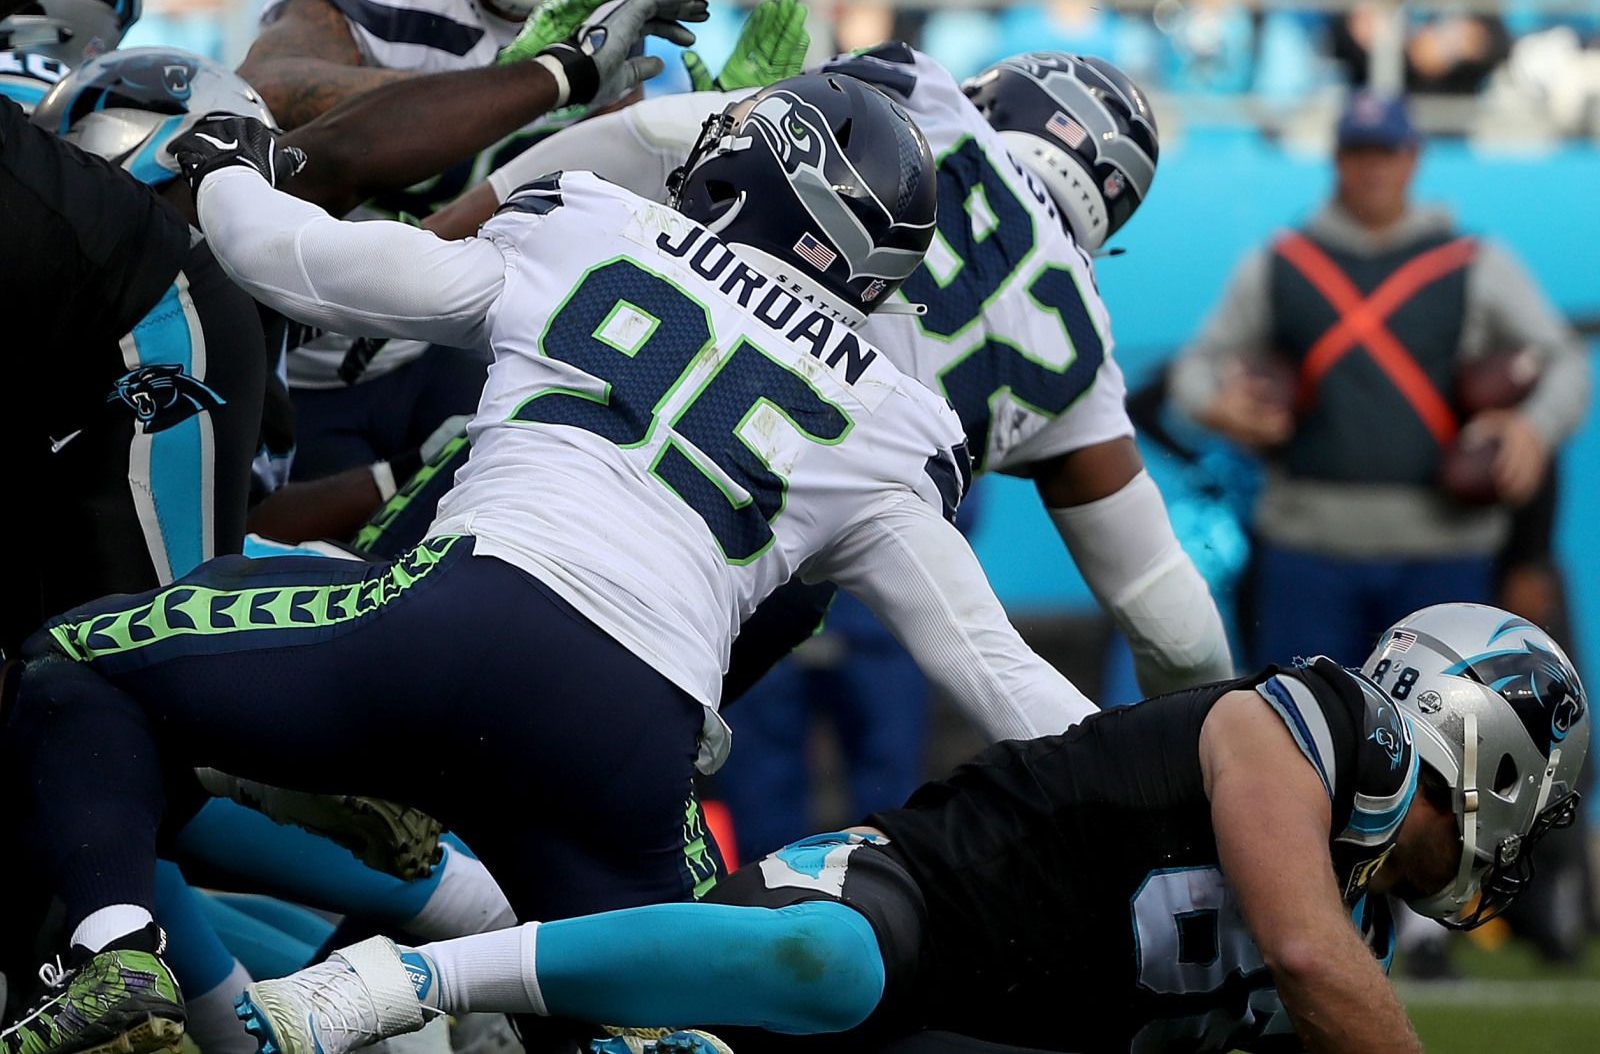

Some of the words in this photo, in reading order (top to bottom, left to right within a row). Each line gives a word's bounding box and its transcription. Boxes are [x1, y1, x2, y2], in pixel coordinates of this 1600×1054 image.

[503, 254, 856, 566] 95
[656, 227, 877, 386] JORDAN
[898, 133, 1105, 474] 92
[1371, 659, 1420, 701] 88
